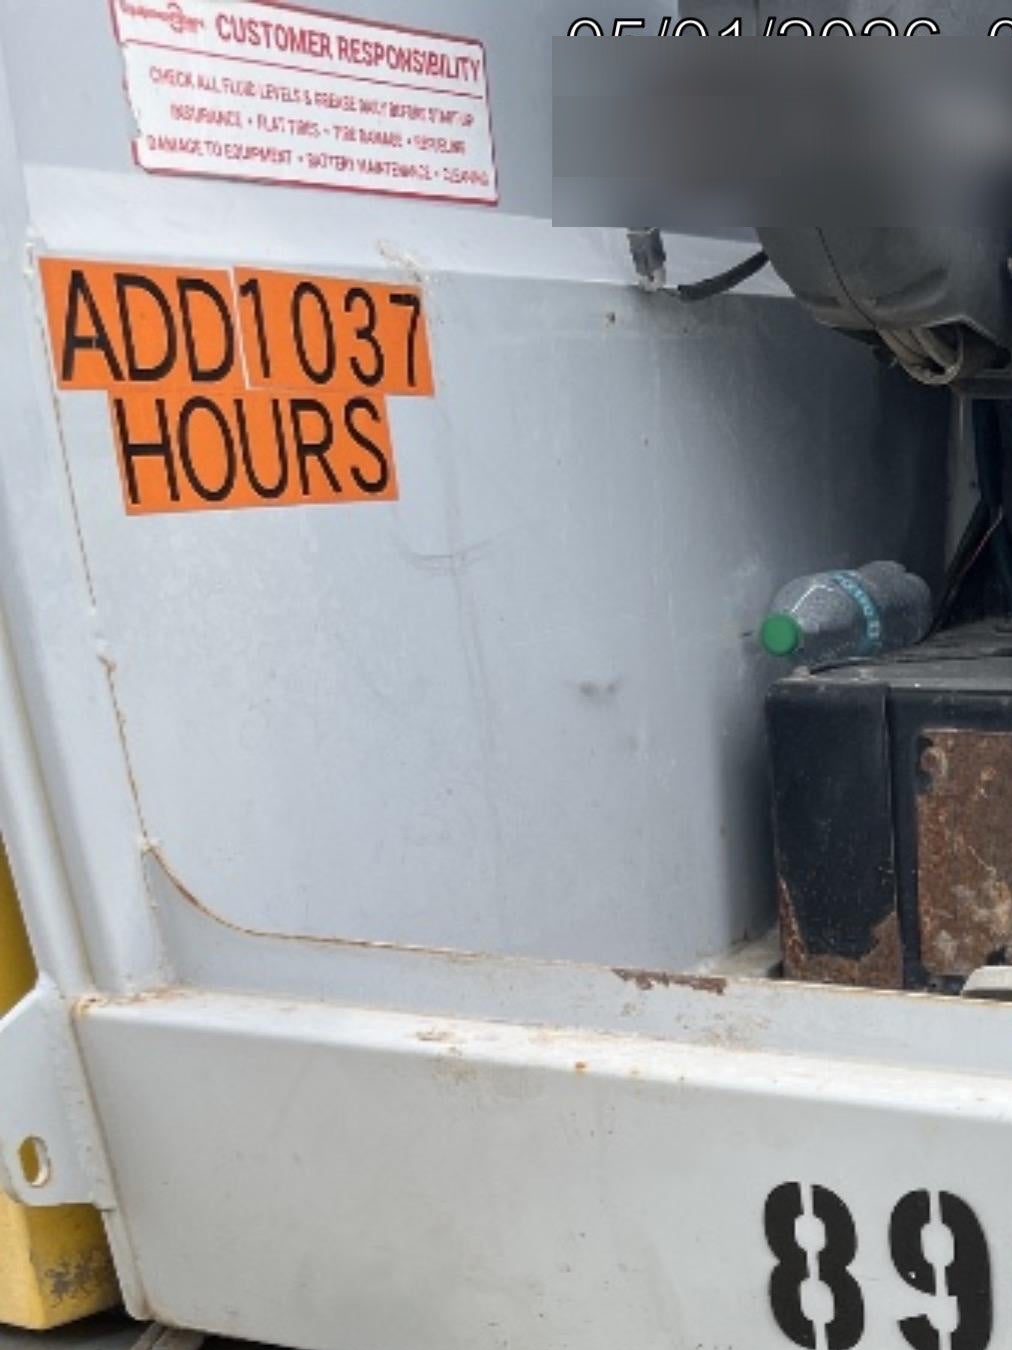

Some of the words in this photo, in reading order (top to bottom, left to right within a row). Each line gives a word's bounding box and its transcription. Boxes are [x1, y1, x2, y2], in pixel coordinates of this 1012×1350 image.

[215, 13, 333, 60] CUSTOMER
[336, 35, 481, 82] RESPONSIBILITY
[111, 395, 390, 505] HOURS
